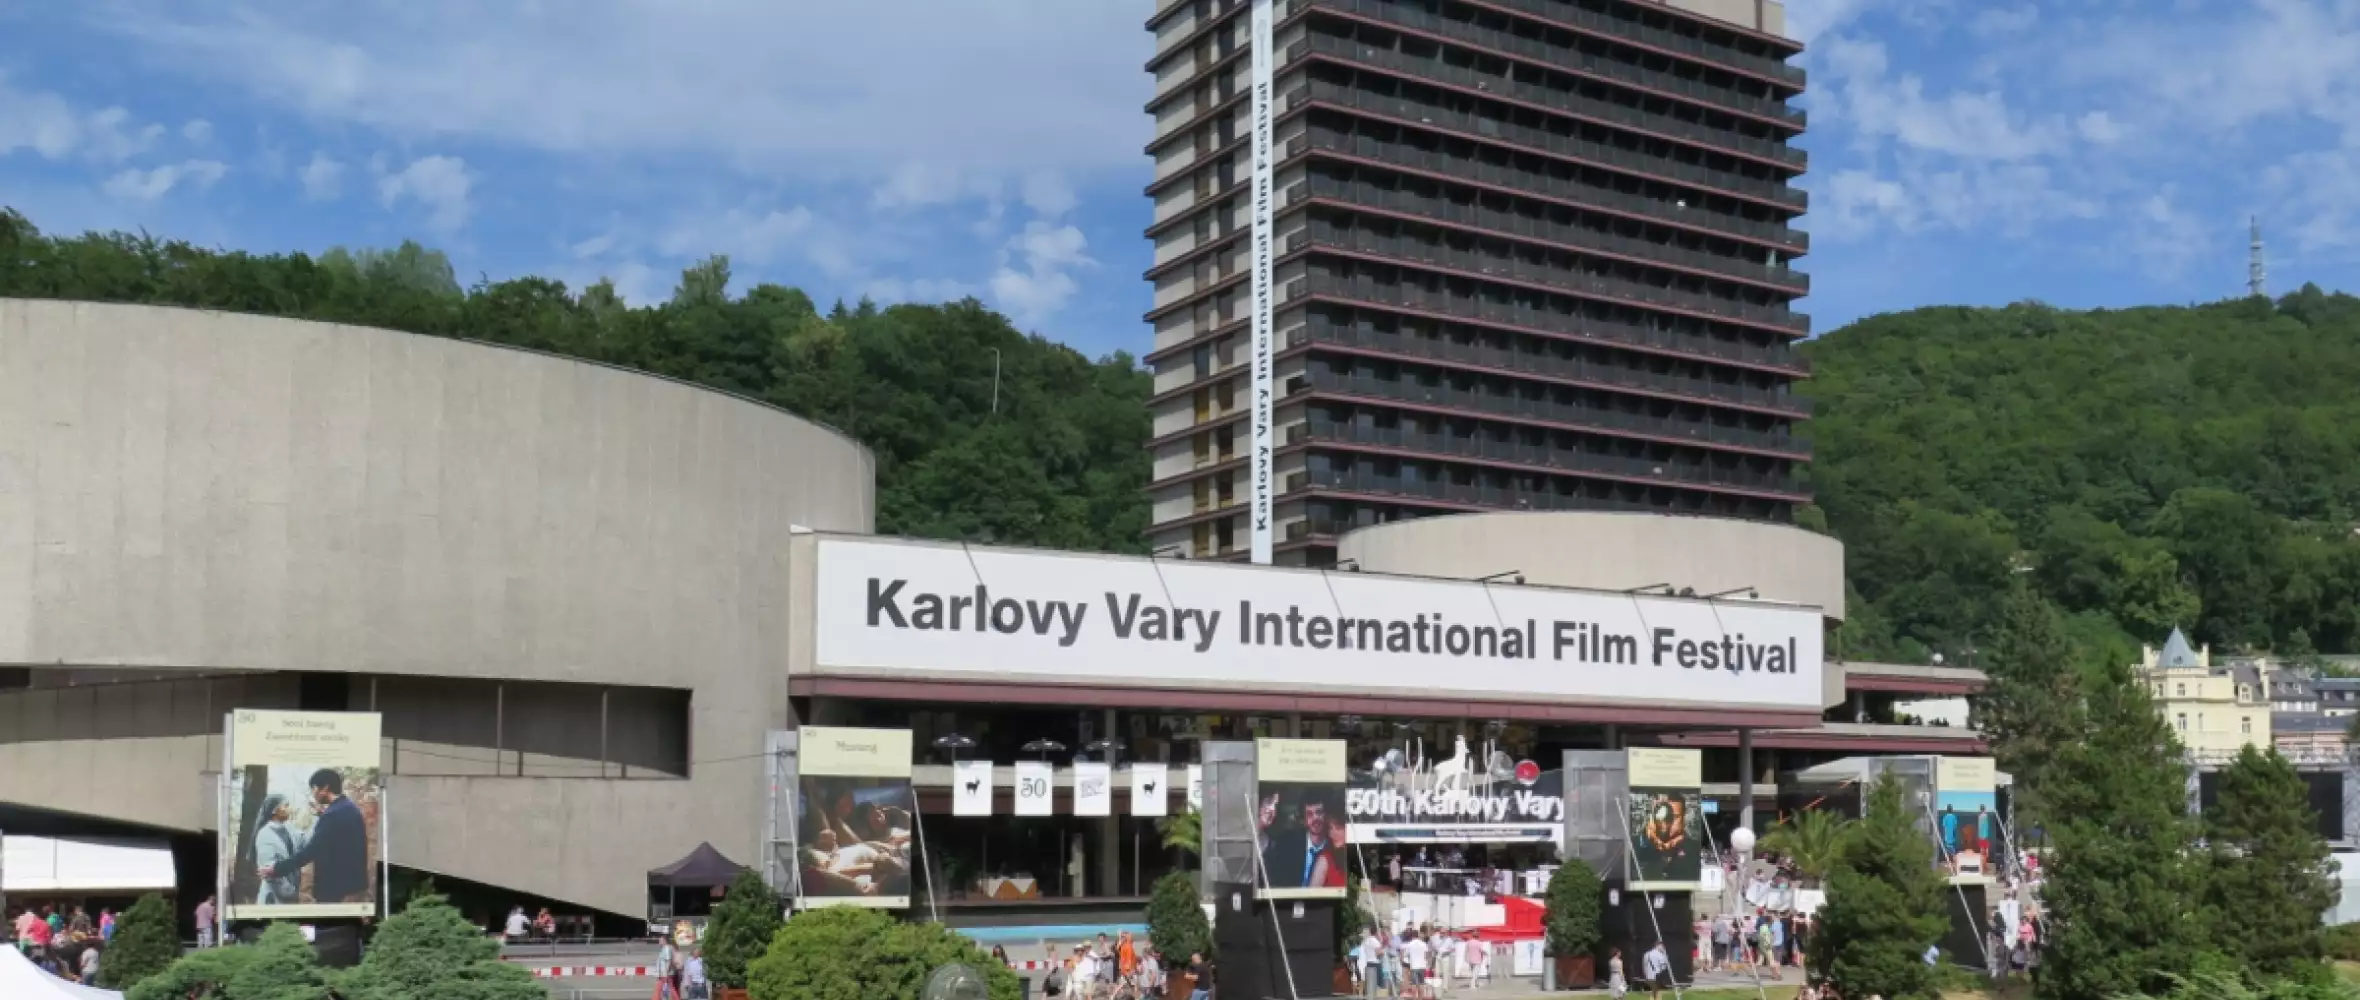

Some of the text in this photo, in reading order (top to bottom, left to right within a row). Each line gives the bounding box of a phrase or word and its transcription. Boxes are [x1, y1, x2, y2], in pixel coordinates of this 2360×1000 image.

[1256, 82, 1269, 531] Karlovy Vary International Film Festival
[867, 577, 1797, 674] Karlovy Vary International Film Festival
[1020, 778, 1048, 798] 50
[1346, 788, 1405, 815] 50th
[1514, 789, 1564, 822] Vary
